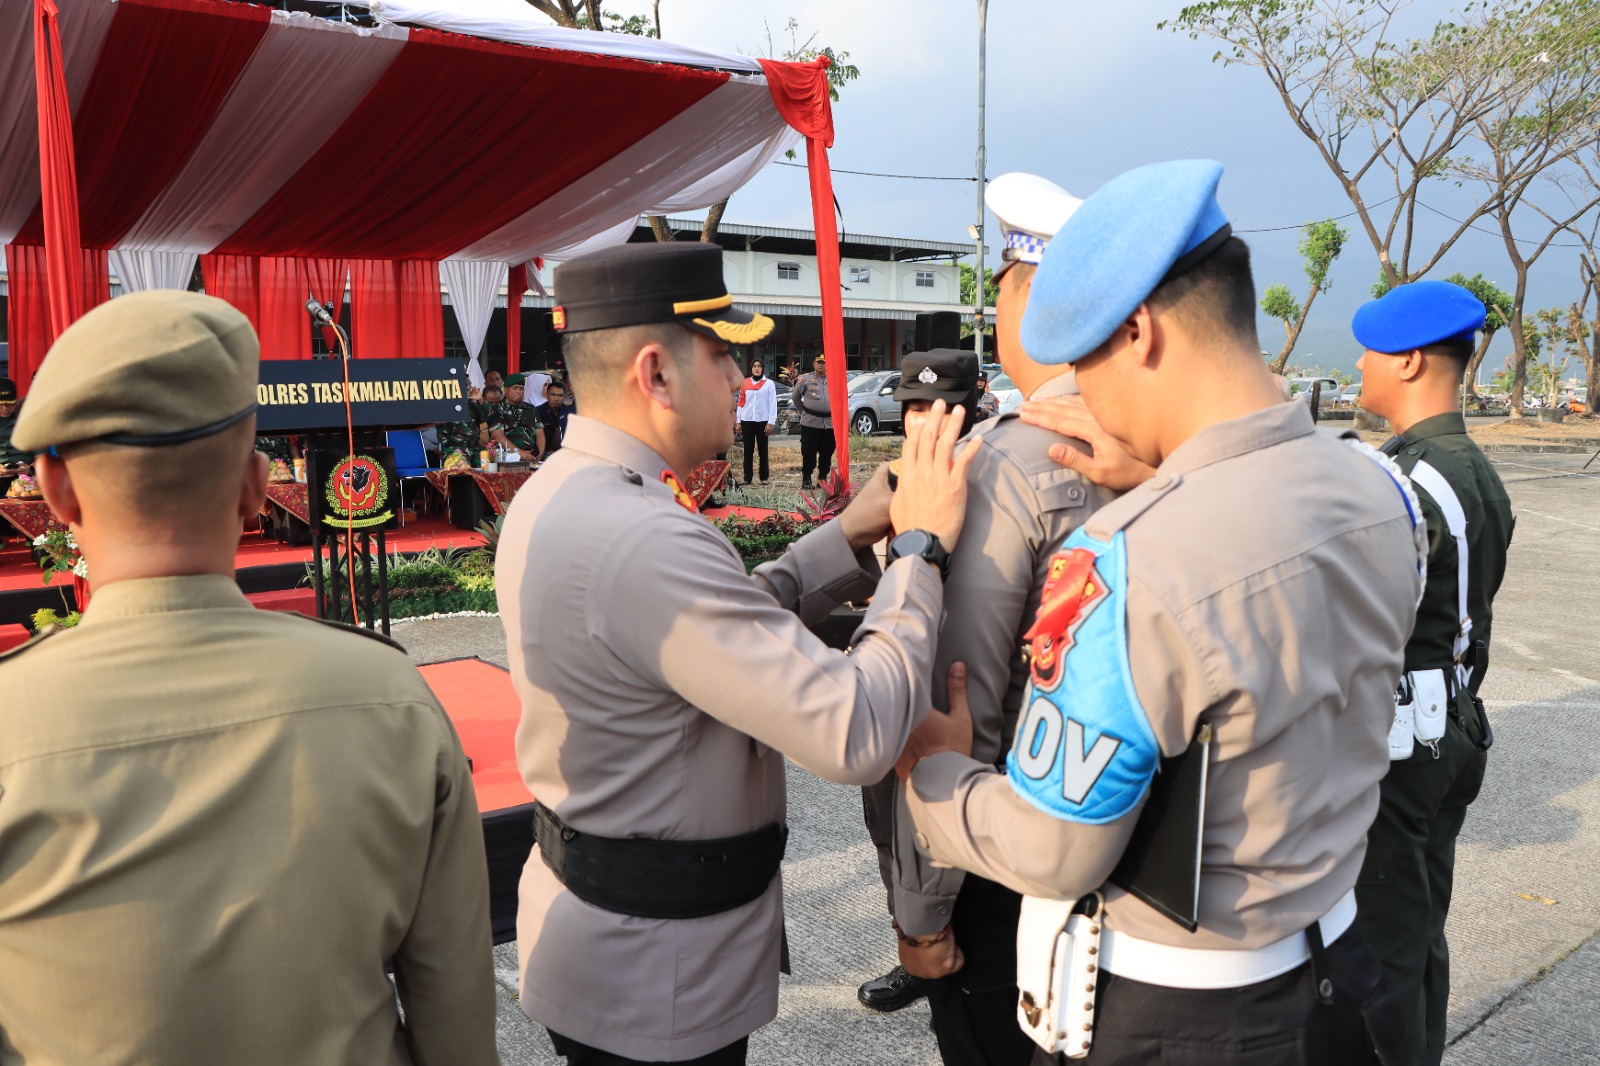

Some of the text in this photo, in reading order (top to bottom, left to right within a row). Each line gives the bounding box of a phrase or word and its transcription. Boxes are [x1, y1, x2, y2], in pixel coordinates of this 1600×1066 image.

[256, 379, 463, 406] OLRES TASIKMALAYA KOTA
